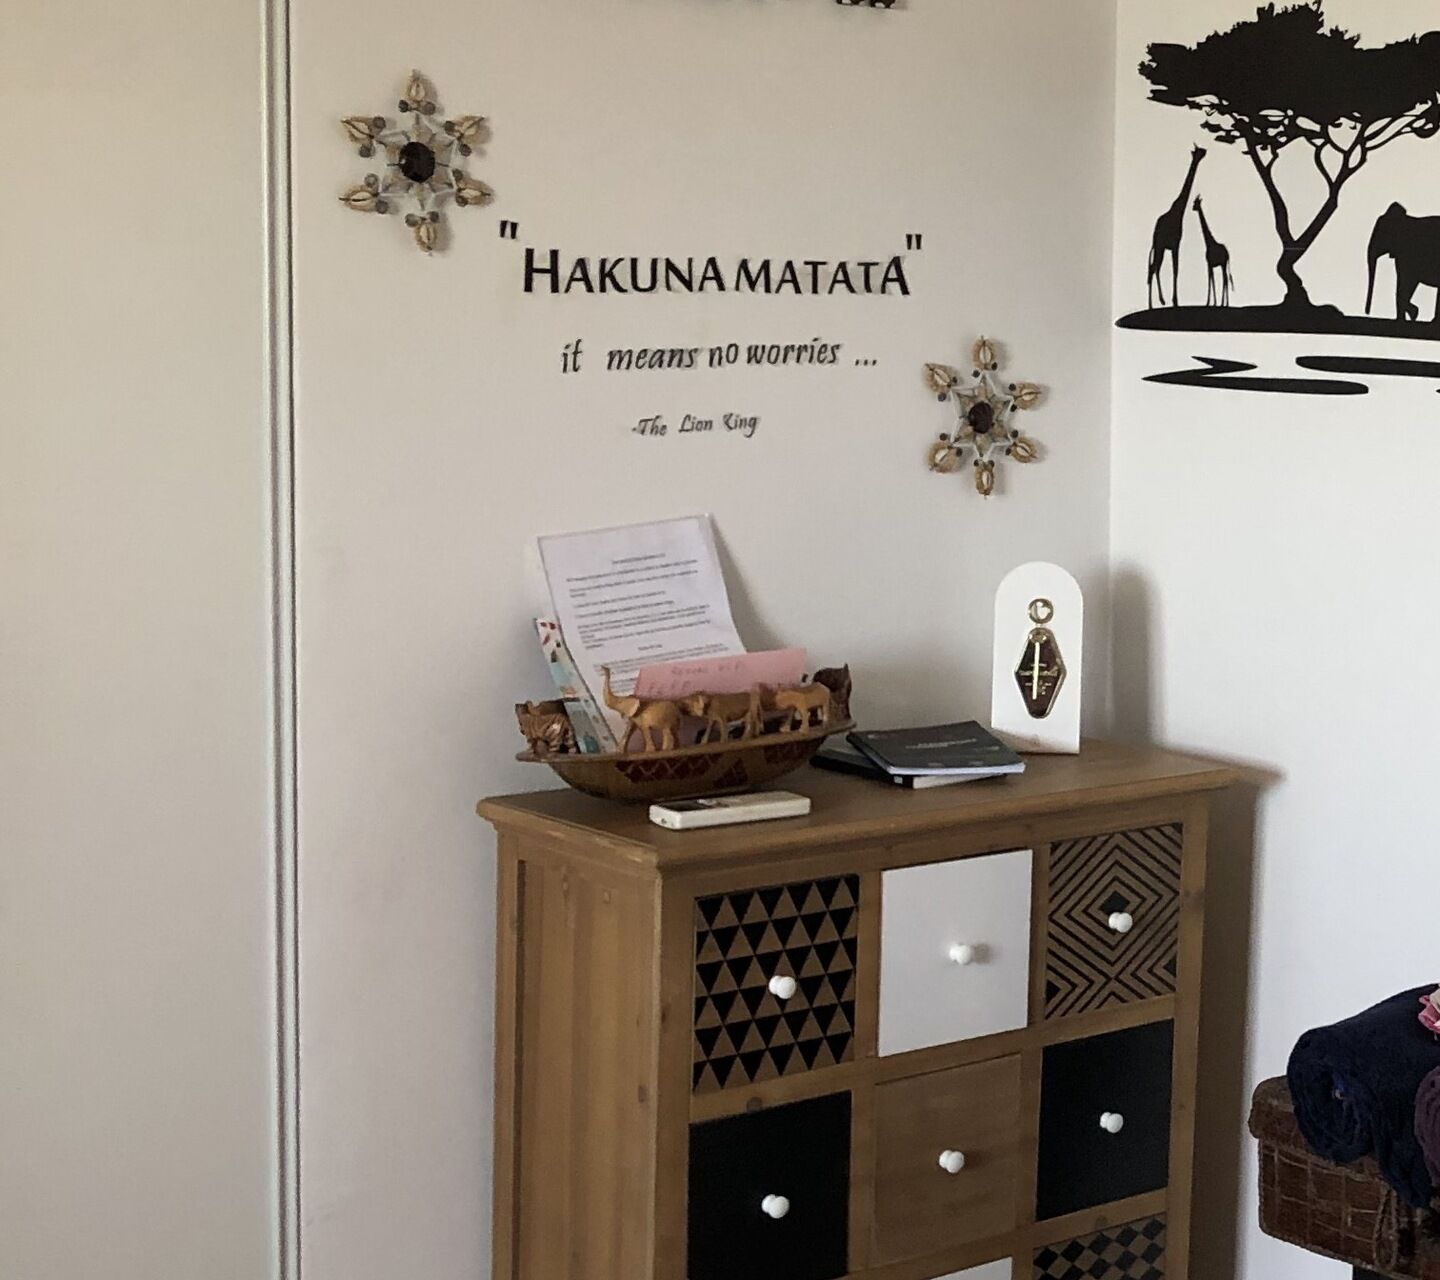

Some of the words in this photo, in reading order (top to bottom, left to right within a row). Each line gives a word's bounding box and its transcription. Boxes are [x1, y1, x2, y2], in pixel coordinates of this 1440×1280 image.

[562, 338, 584, 374] it
[606, 347, 700, 371] means
[708, 342, 740, 368] no
[746, 337, 842, 366] worries
[677, 413, 714, 434] Lion
[722, 412, 760, 439] King
